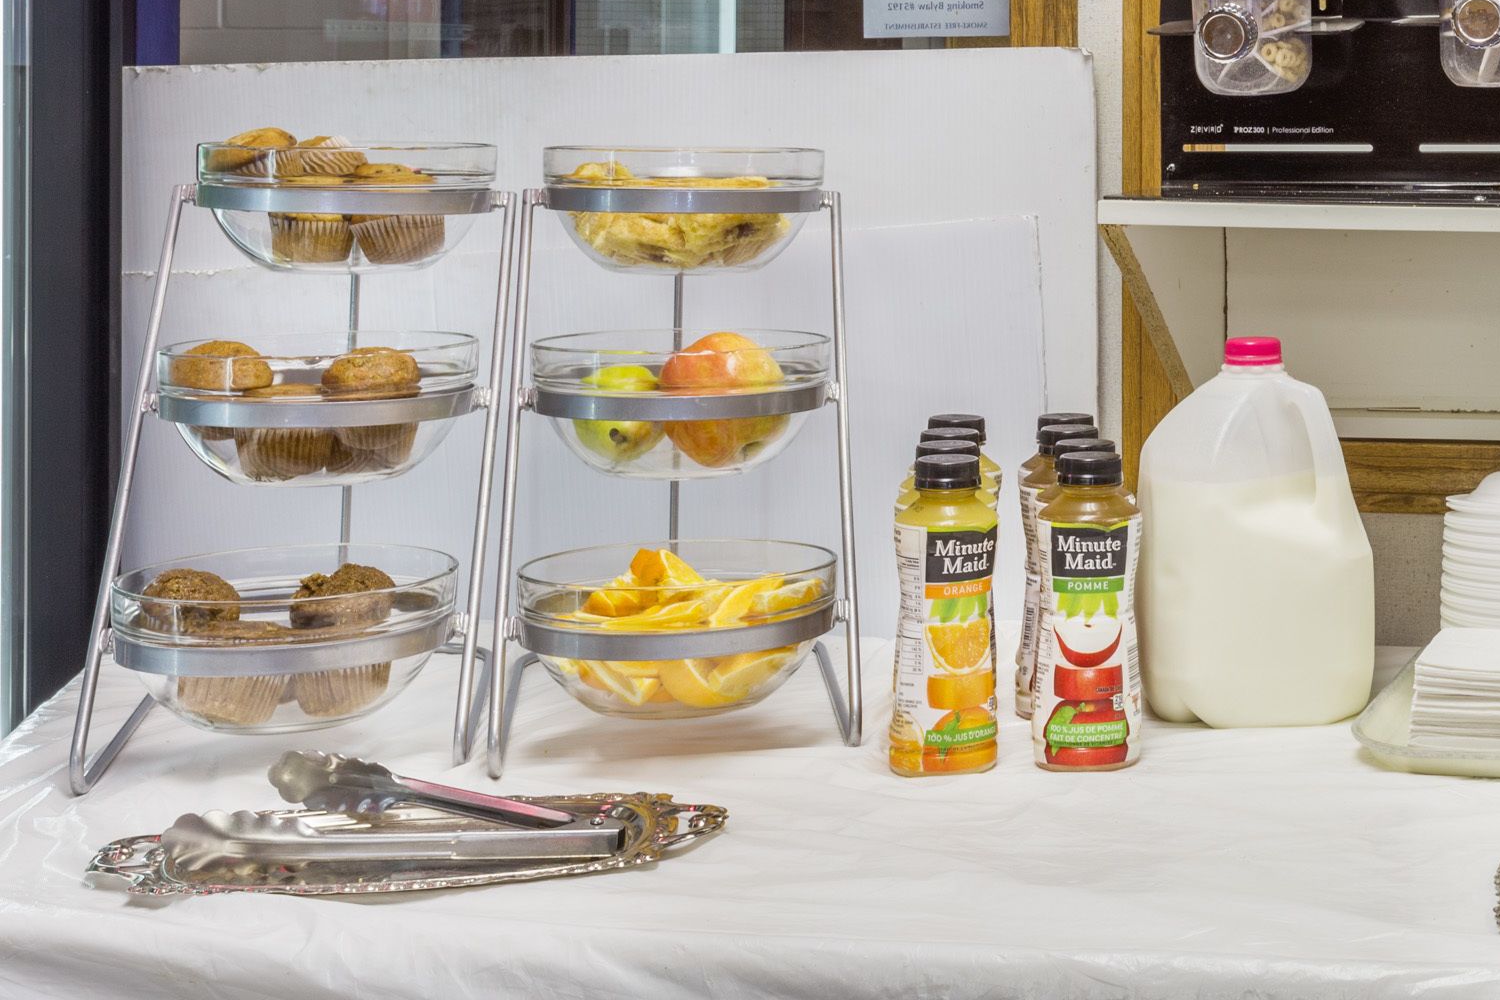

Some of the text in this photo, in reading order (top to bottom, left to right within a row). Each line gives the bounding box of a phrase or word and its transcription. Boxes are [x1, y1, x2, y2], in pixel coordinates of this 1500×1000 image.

[1272, 126, 1310, 134] Professional
[934, 538, 994, 557] Minute
[1057, 535, 1121, 552] Minute
[942, 554, 988, 574] Maid
[1064, 553, 1113, 570] Maid
[944, 582, 983, 596] ORANGE
[1067, 581, 1109, 591] POMME
[928, 734, 943, 742] 100
[943, 734, 952, 742] %
[953, 732, 968, 742] JUS
[1069, 726, 1084, 734] JUS
